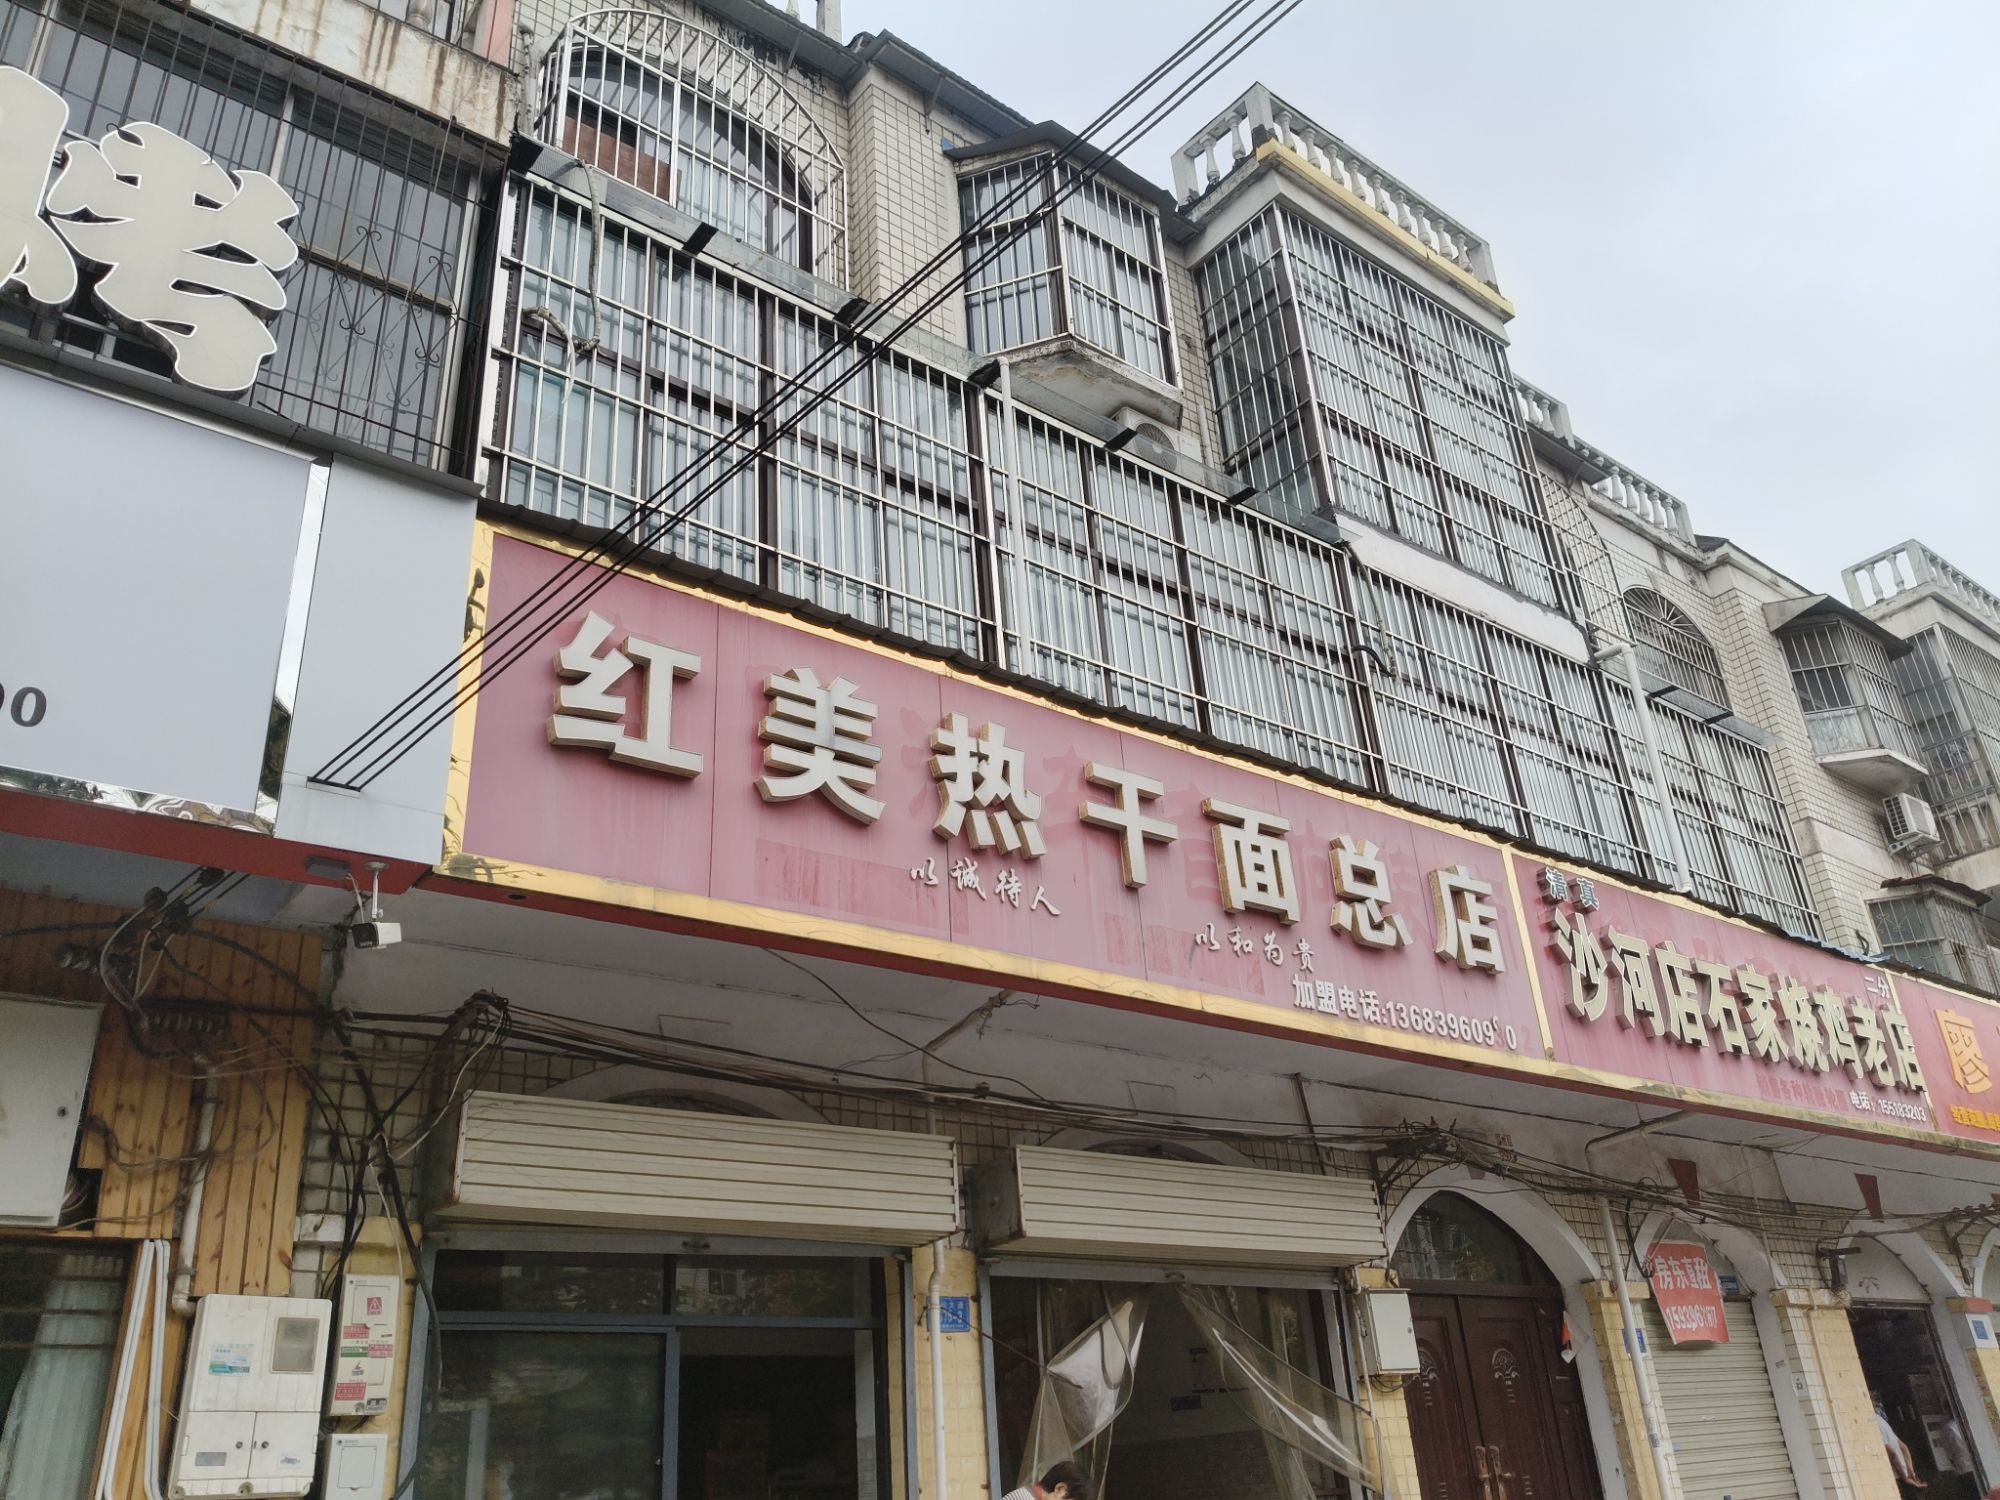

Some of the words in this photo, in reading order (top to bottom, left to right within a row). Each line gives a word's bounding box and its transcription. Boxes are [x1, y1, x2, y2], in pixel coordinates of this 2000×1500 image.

[546, 609, 1508, 977] 红美热干面总店
[1540, 866, 1600, 911] 清真
[1194, 922, 1317, 974] 以和为贵
[1550, 908, 1926, 1093] 沙河店石家烧鸡老店
[1654, 1255, 1713, 1291] 房东直租
